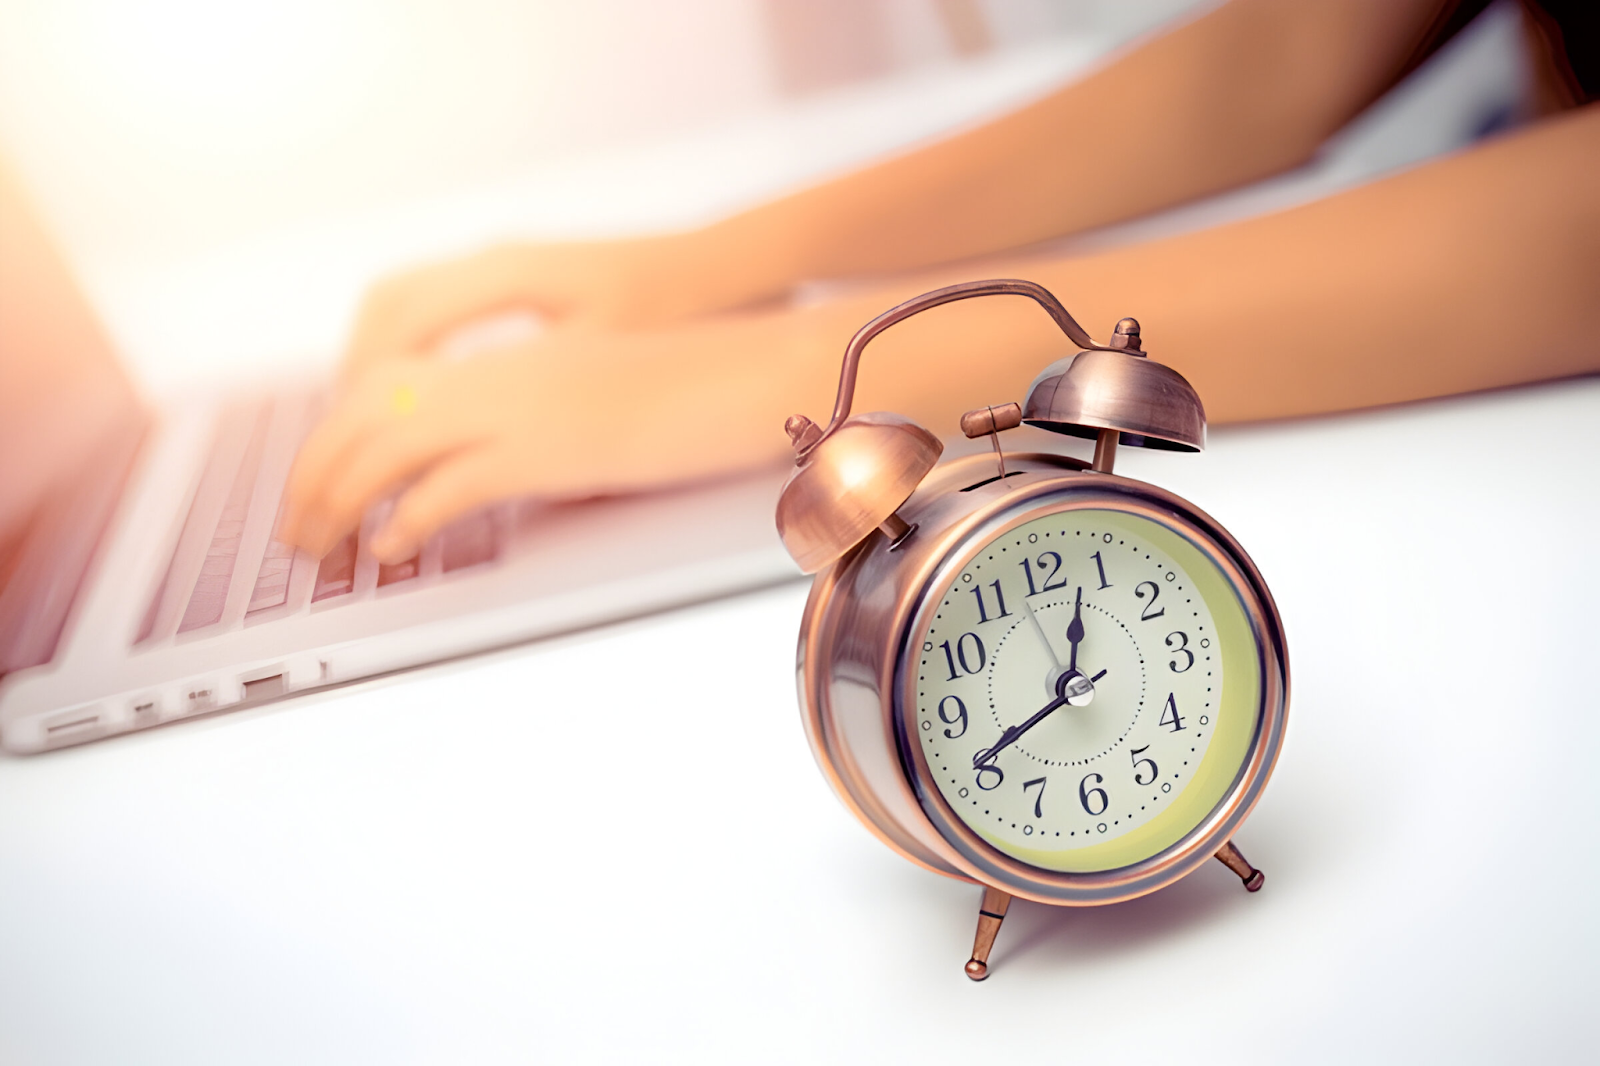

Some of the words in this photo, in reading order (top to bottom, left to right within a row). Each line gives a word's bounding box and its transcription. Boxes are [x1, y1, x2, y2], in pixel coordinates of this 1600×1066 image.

[1018, 551, 1067, 598] 12
[1090, 551, 1114, 590] 1
[969, 579, 1013, 624] 11
[1135, 581, 1165, 621] 2
[939, 632, 987, 681] 10
[1165, 631, 1195, 673] 3
[937, 695, 969, 739] 9
[1158, 692, 1187, 733] 4
[973, 748, 1004, 790] 8
[1130, 745, 1159, 785] 5
[1023, 776, 1047, 818] 7
[1079, 773, 1108, 815] 6
